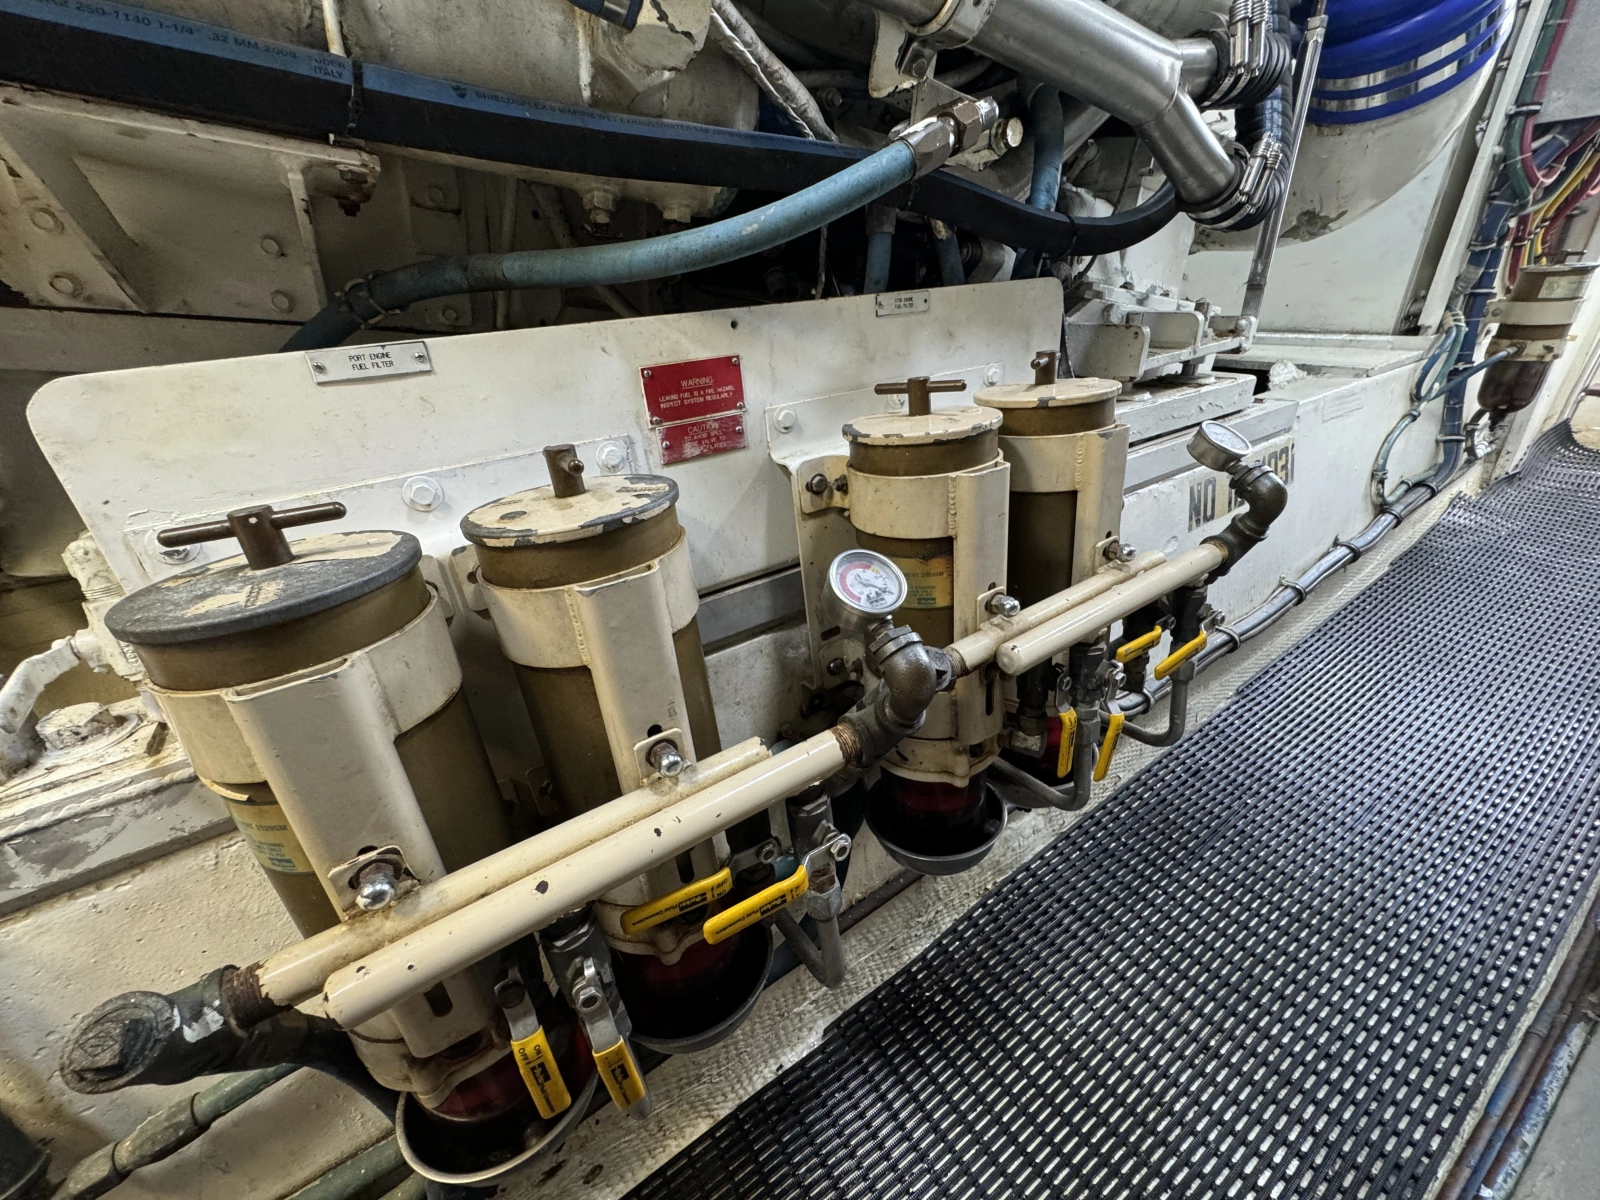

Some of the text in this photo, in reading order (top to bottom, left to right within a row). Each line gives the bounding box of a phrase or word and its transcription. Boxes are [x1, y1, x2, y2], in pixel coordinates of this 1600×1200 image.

[234, 37, 259, 50] MM
[313, 64, 344, 79] ITALY
[348, 352, 392, 362] PORT ENGINE
[371, 361, 394, 370] FILTER
[681, 376, 713, 388] WARNING
[659, 393, 678, 402] LEAKING
[680, 391, 692, 399] FUEL
[705, 387, 715, 395] FIRE
[660, 392, 733, 409] INSPECT SYSTEM REGULARLY
[1188, 477, 1217, 532] NO
[716, 878, 728, 889] OFF
[717, 889, 728, 898] ON
[518, 1047, 529, 1063] OFF
[533, 1044, 542, 1056] ON
